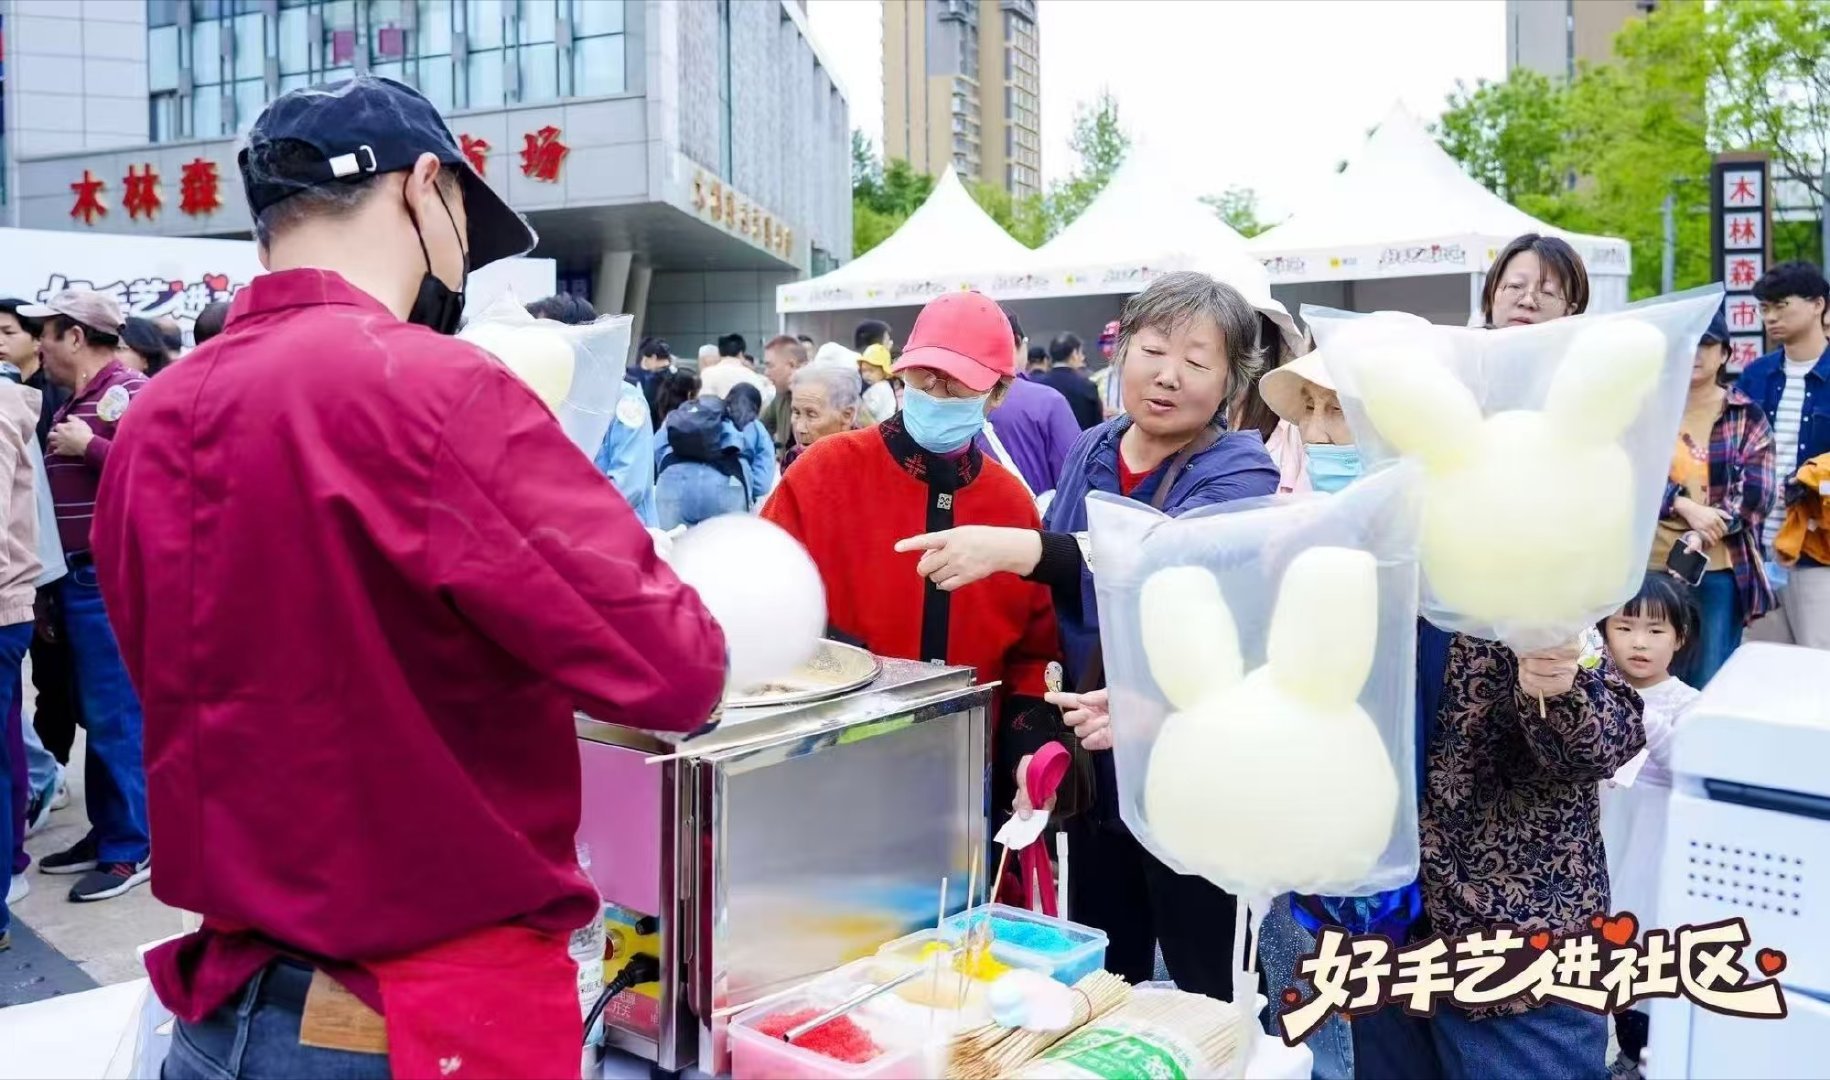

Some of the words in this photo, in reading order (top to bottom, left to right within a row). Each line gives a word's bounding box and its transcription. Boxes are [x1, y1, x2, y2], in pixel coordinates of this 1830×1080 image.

[69, 157, 222, 223] 木林森
[1729, 176, 1757, 362] 木林森市场
